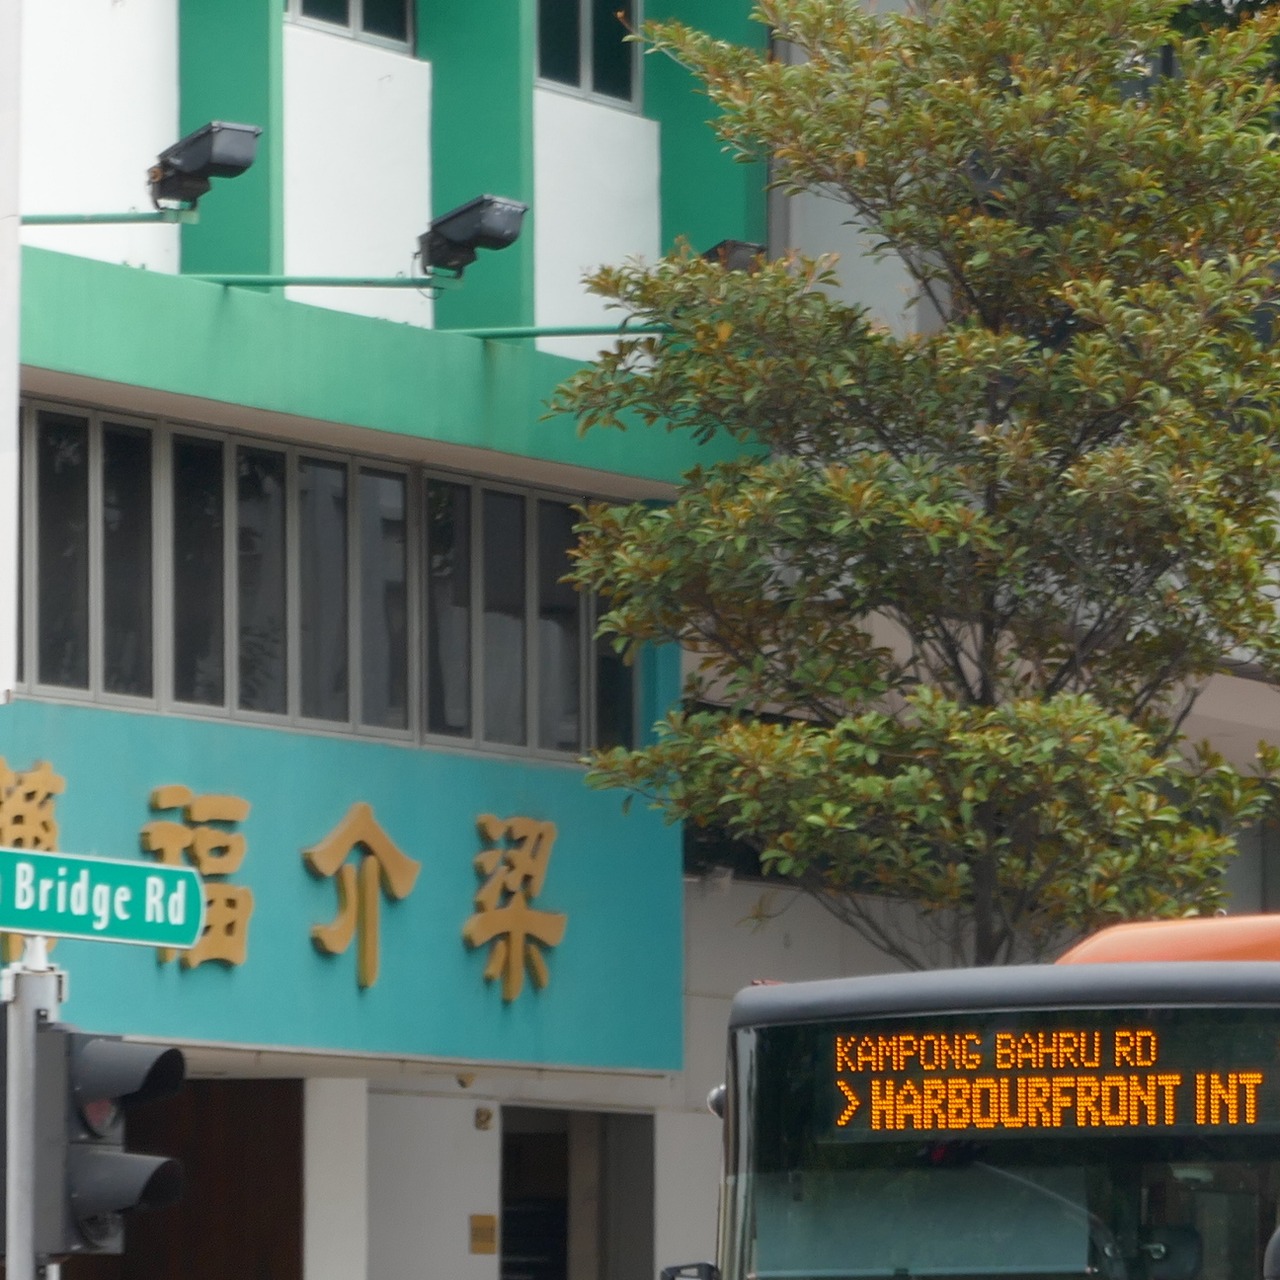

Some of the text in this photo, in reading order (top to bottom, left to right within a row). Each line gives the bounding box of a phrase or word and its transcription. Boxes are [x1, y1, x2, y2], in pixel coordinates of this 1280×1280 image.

[14, 861, 187, 931] Bridge Rd
[836, 1030, 1157, 1072] KAMPONG BAHRU RD
[871, 1072, 1263, 1130] HARBOURFRONT INT
